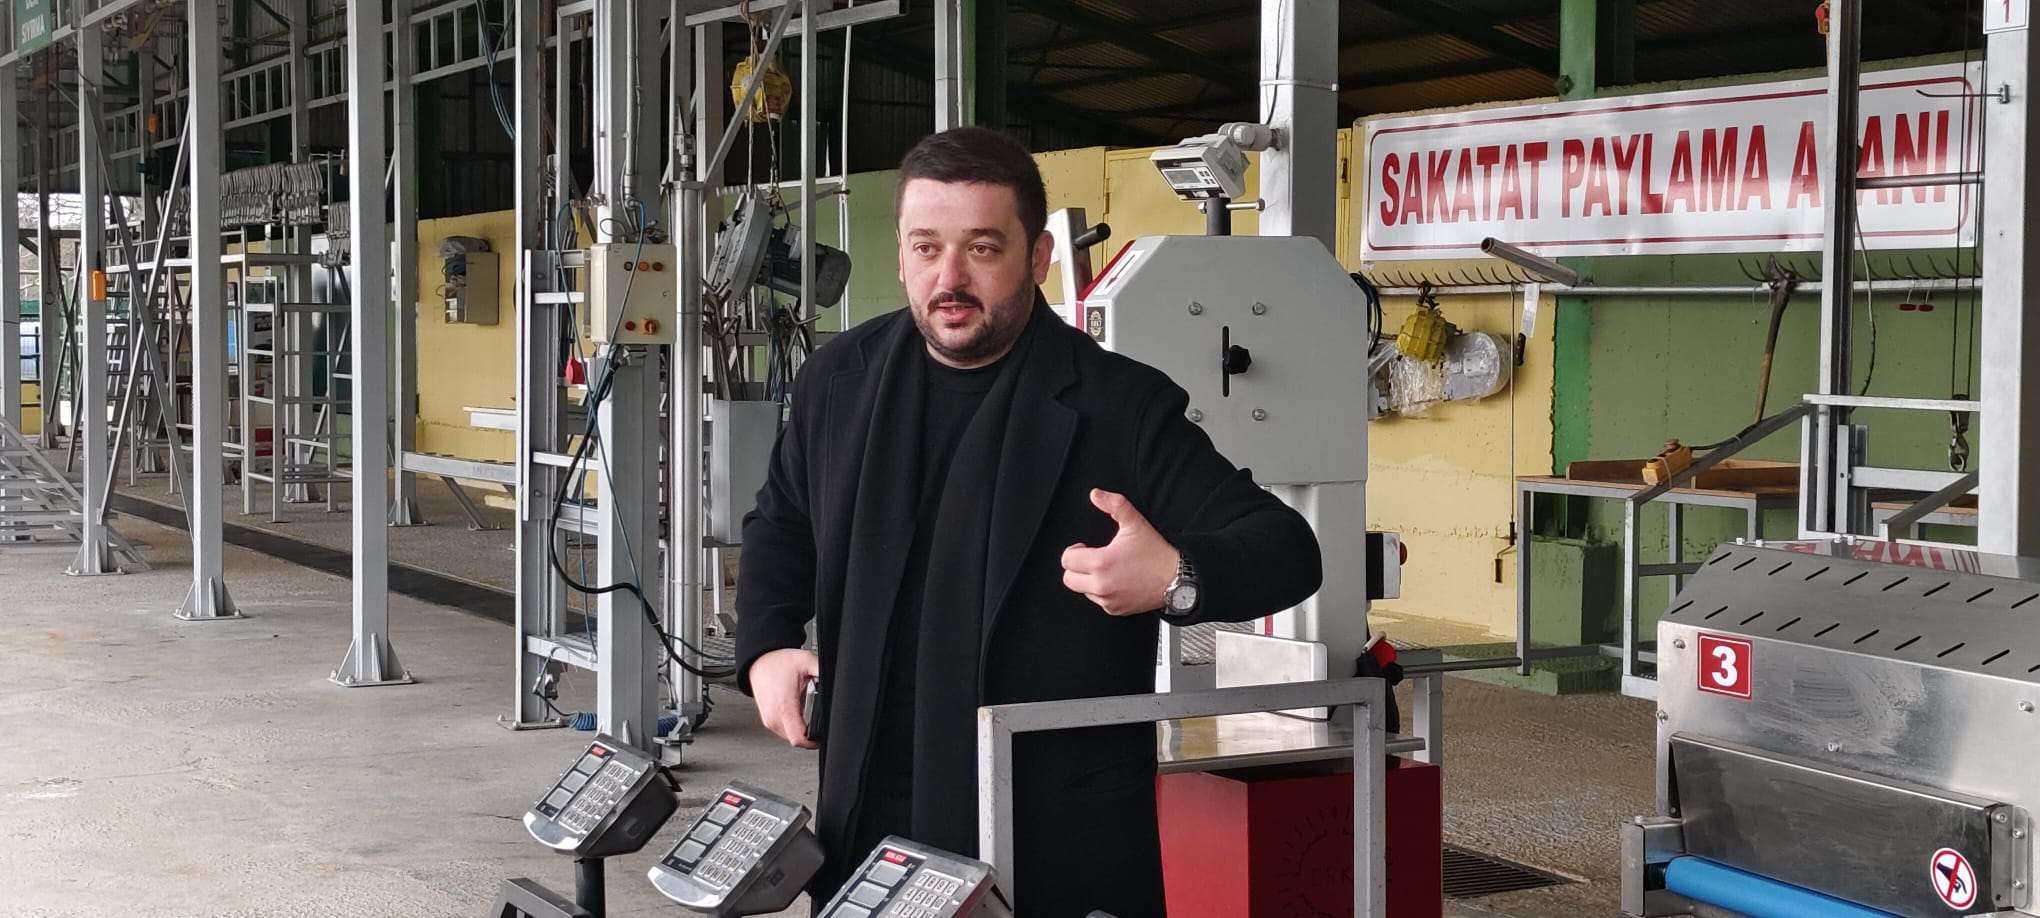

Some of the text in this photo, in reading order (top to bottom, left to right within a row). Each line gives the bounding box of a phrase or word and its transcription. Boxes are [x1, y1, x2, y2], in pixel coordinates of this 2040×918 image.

[1380, 110, 1949, 227] SAKATAT PAYLAMA AANI
[1711, 645, 1738, 687] 3
